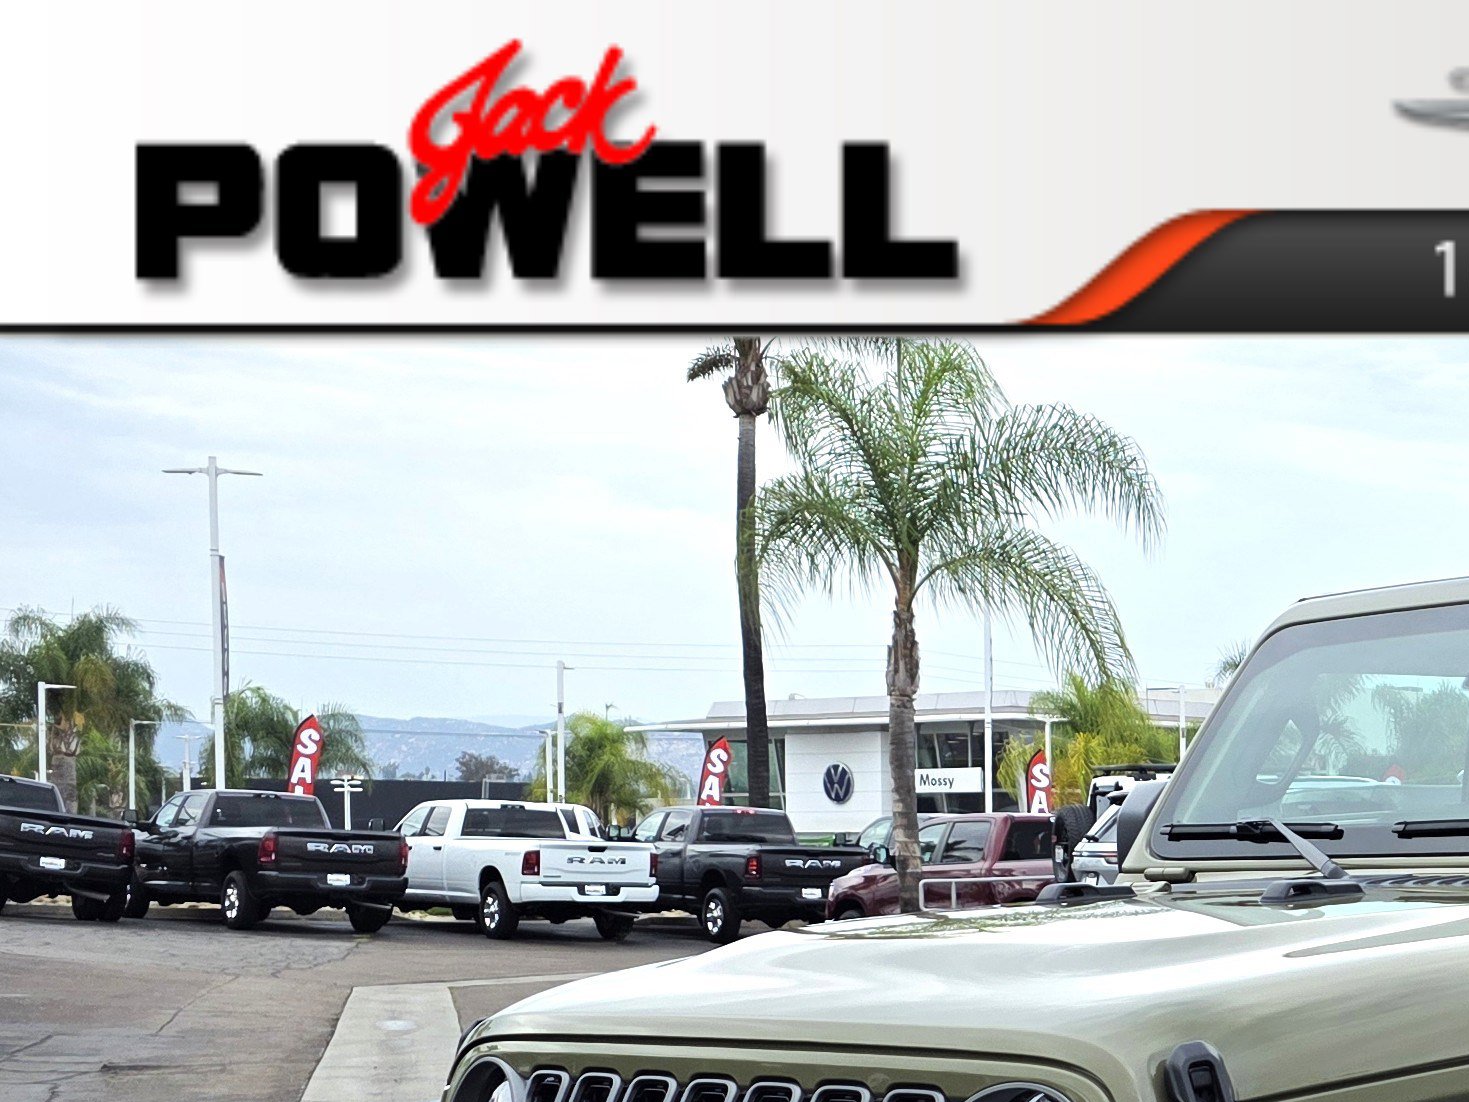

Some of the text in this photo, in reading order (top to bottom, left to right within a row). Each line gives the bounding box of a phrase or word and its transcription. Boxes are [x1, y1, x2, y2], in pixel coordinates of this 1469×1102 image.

[919, 773, 955, 790] Mossy
[20, 822, 95, 840] RAM
[306, 842, 374, 855] RAM
[566, 856, 627, 865] RAM
[784, 859, 841, 869] RAM
